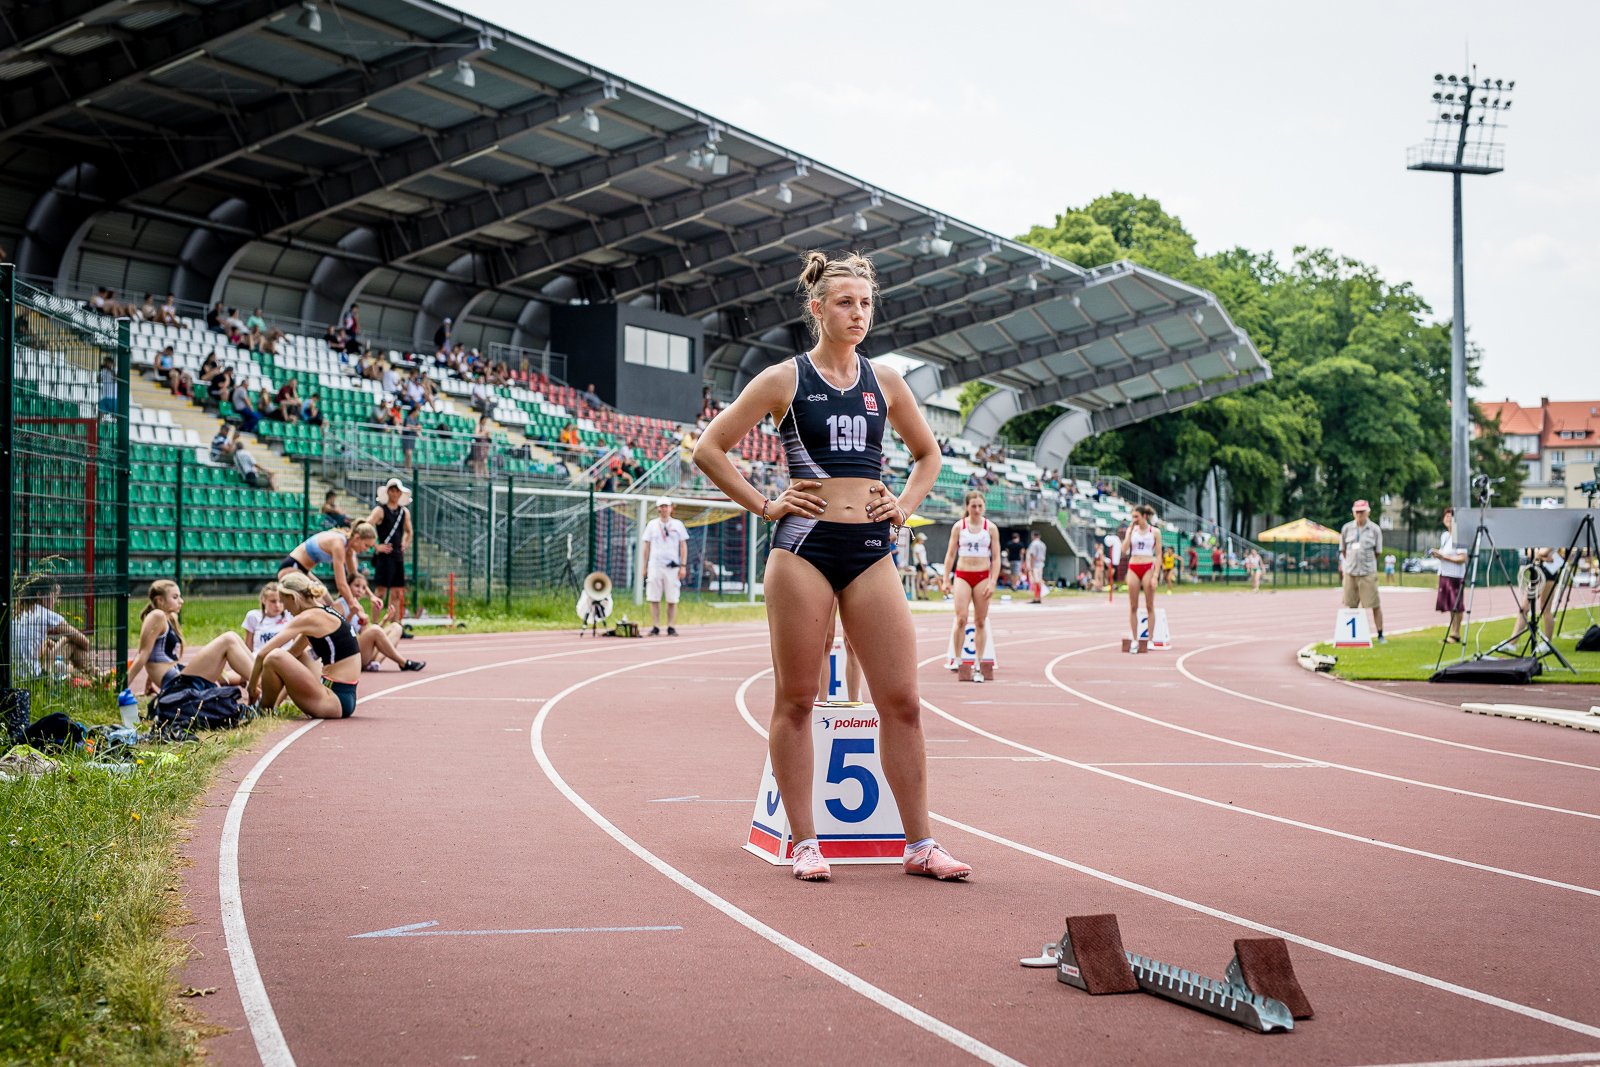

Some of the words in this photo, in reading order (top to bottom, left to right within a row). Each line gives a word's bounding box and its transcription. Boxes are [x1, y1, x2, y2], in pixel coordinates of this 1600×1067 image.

[807, 393, 828, 402] esa
[826, 414, 867, 452] 130
[864, 539, 882, 547] esa
[1346, 617, 1356, 638] 1
[834, 717, 879, 730] polanik
[824, 738, 880, 824] 5
